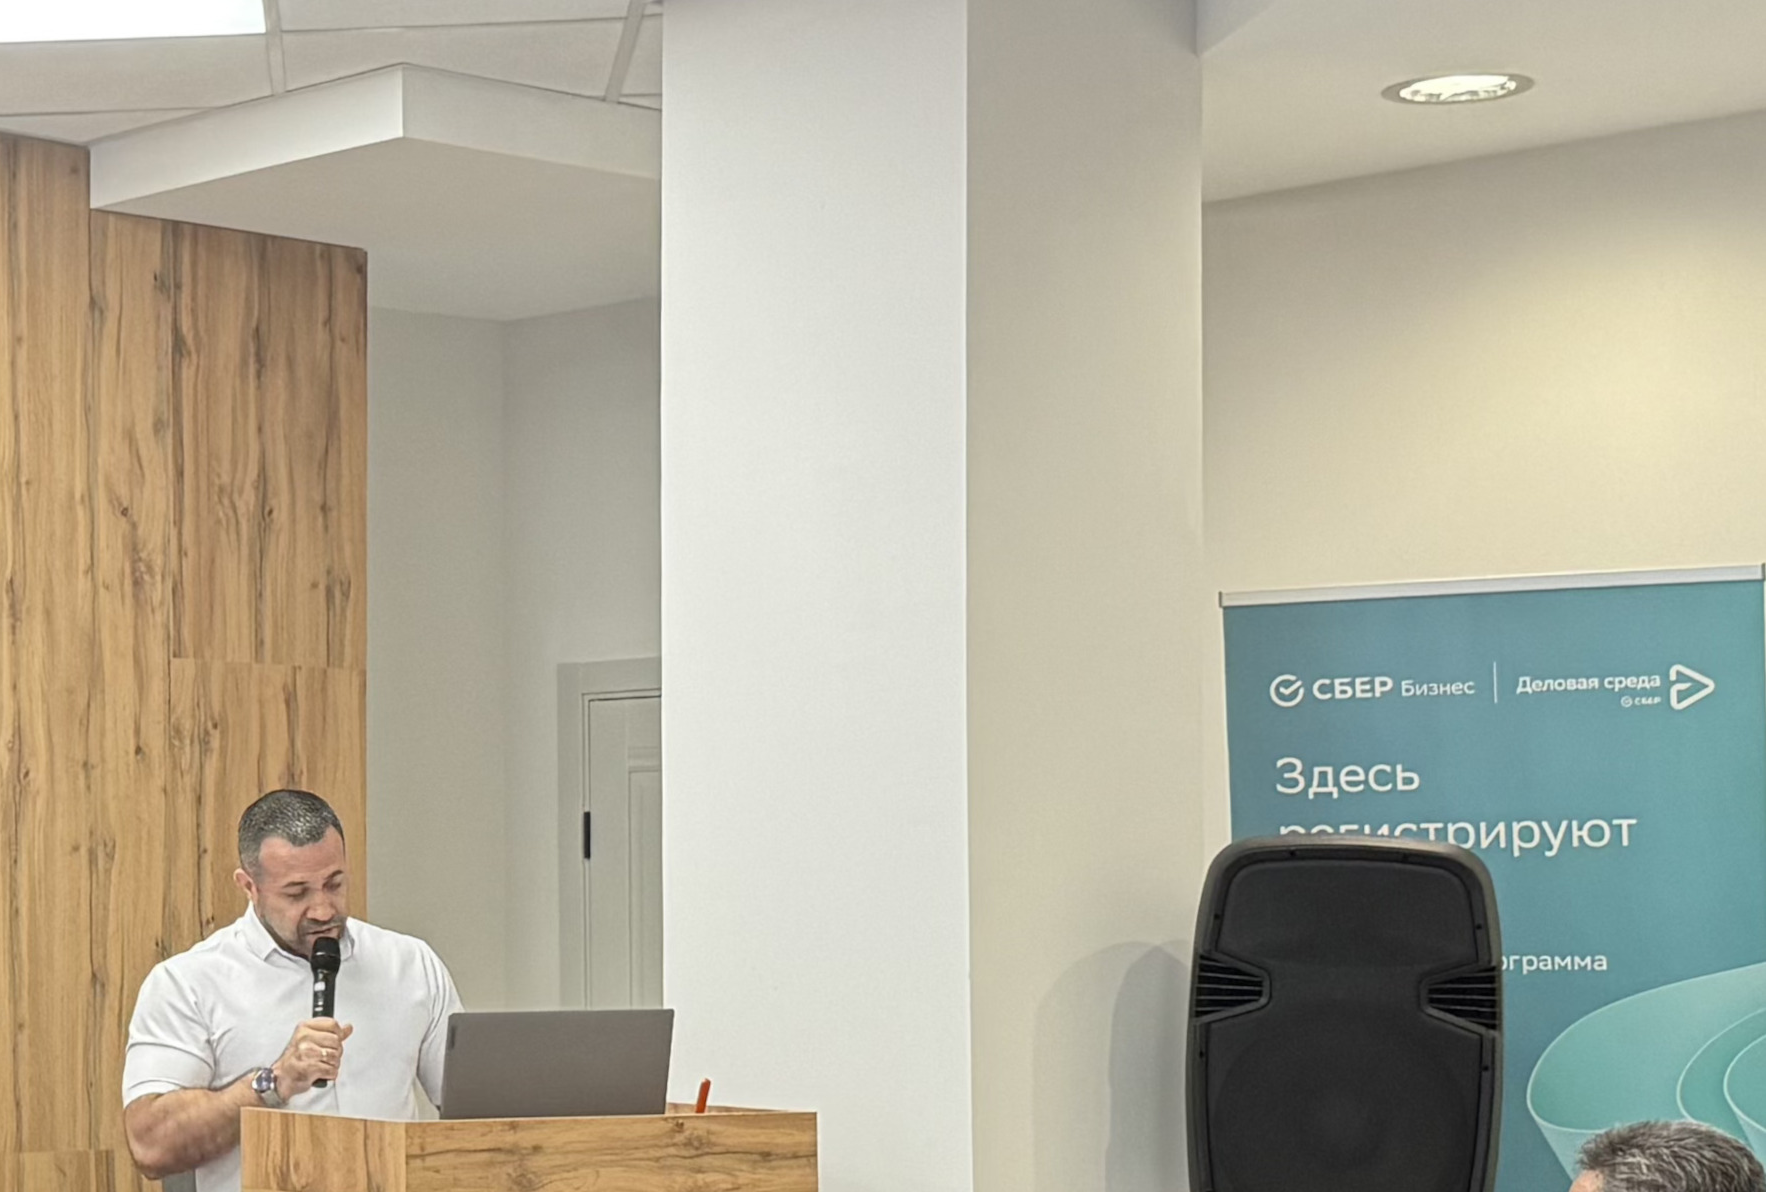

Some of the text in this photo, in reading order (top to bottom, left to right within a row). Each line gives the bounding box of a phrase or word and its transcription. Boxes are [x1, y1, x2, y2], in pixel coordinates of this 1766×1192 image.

[1312, 676, 1475, 699] СБЕР Бизнес
[1516, 672, 1662, 695] Деловая среда
[1275, 757, 1421, 799] Здесь
[1280, 818, 1638, 857] трируют
